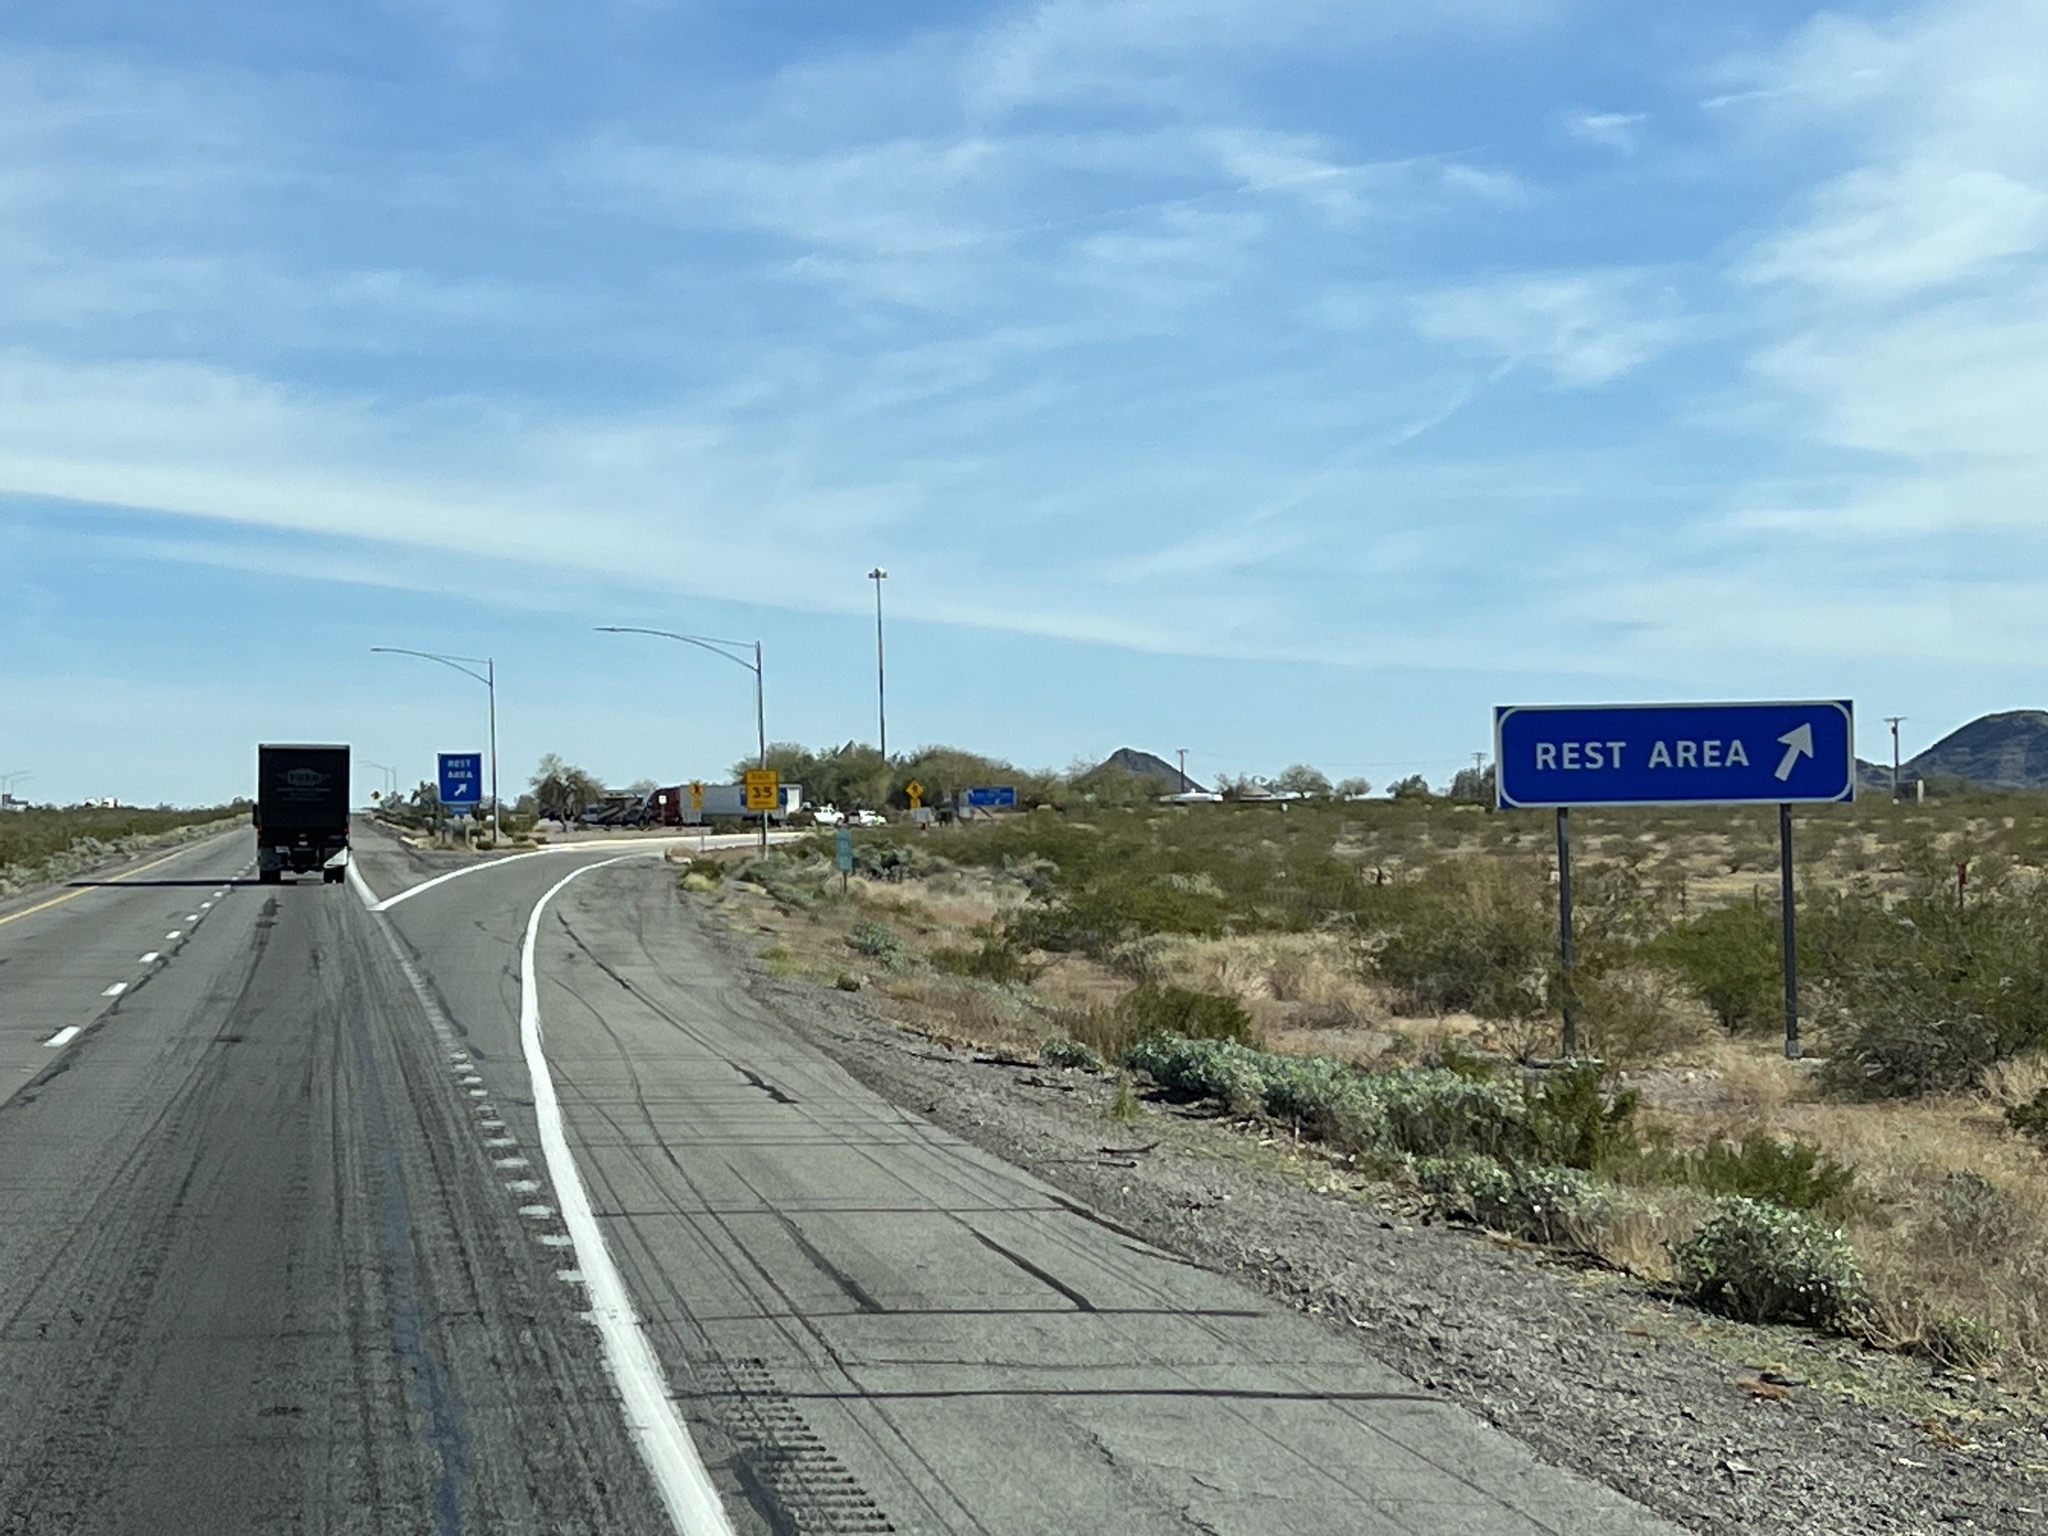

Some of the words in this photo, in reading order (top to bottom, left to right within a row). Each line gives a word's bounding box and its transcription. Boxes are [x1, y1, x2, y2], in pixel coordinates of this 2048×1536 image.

[1535, 741, 1627, 770] REST
[1648, 739, 1750, 769] AREA
[447, 759, 471, 768] REST
[752, 786, 773, 799] 35
